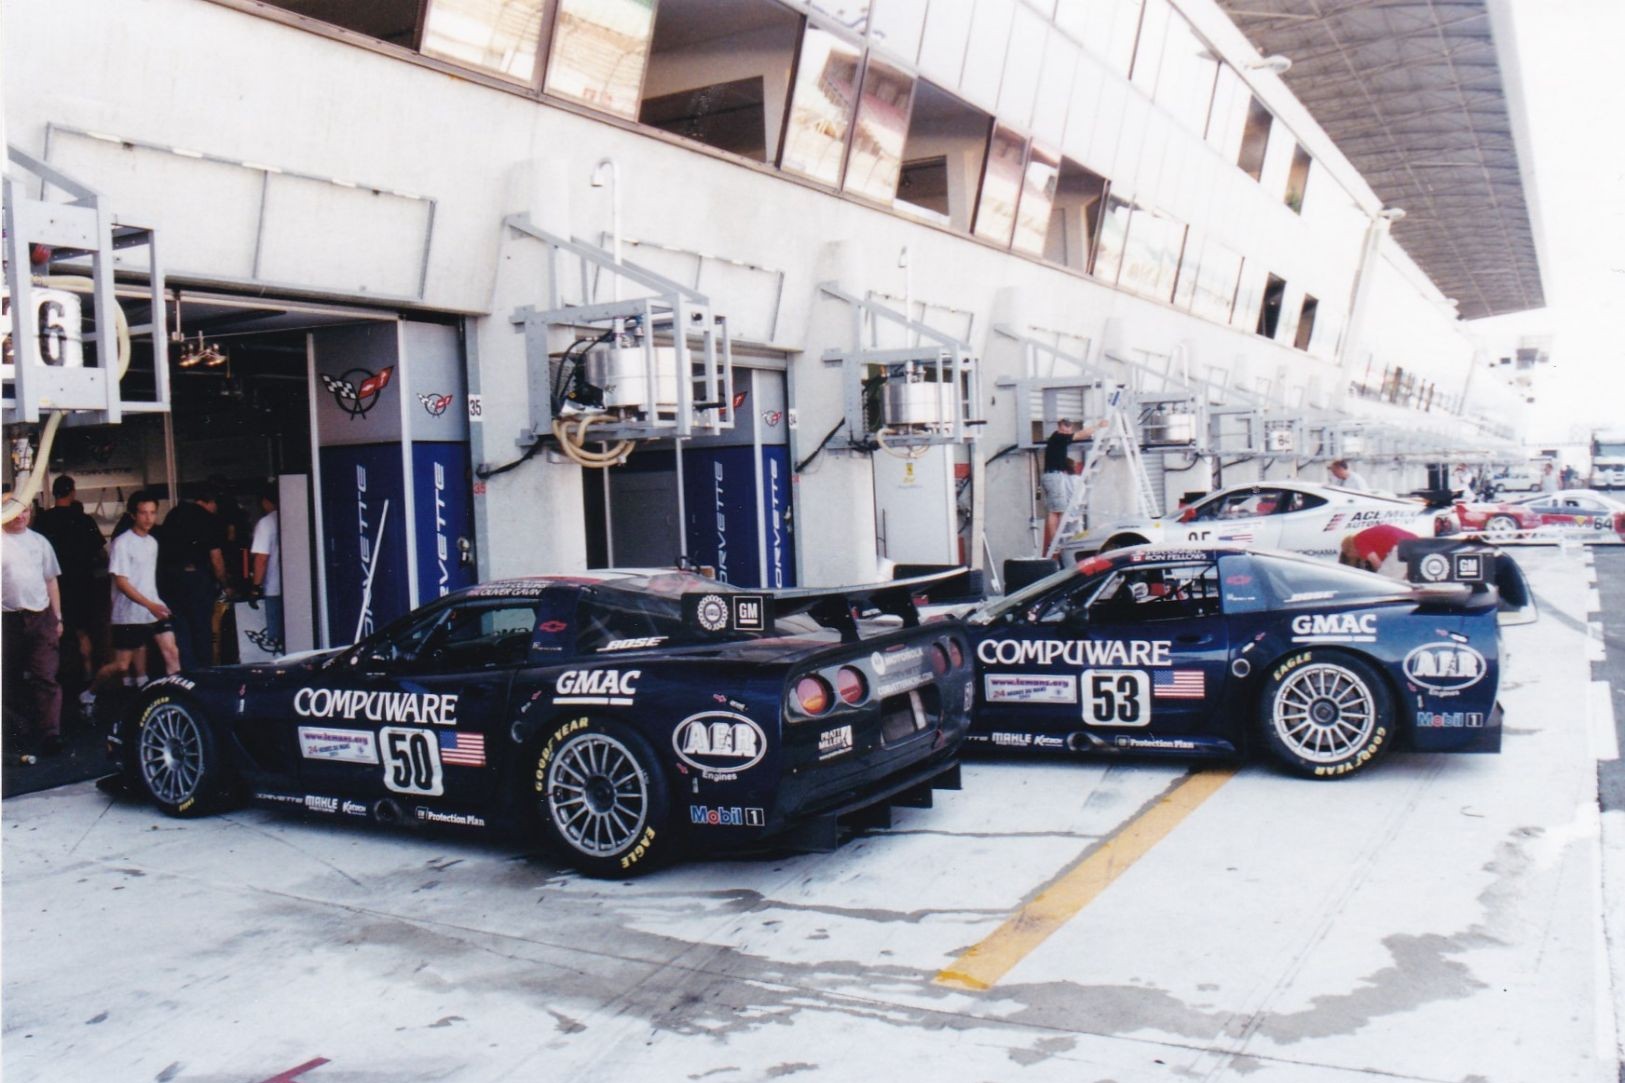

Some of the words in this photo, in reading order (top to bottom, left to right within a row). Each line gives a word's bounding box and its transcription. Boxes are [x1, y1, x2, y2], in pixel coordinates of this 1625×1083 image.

[469, 399, 482, 416] 35
[714, 460, 728, 584] ORVETTE
[769, 457, 782, 589] ORVETTE
[1594, 517, 1613, 530] 64
[1167, 553, 1207, 561] FELLOWS
[739, 602, 758, 619] GM
[1291, 614, 1377, 635] GMAC
[603, 636, 664, 652] BOSE
[976, 638, 1173, 667] COMPUWARE
[1273, 651, 1312, 681] EAGLE
[555, 669, 642, 695] GMAC
[990, 678, 1069, 689] www.lemans.org
[293, 686, 459, 726] COMPUWARE
[1091, 675, 1140, 722] 53
[1416, 711, 1464, 728] Mobil
[682, 720, 757, 757] AER
[991, 731, 1032, 744] MAHLE
[387, 732, 434, 790] 50
[701, 769, 738, 783] Engines
[304, 794, 339, 810] MAHLE
[427, 810, 466, 825] Protection
[466, 815, 486, 827] Plan
[690, 804, 743, 826] Mobil
[620, 826, 656, 869] EAGLE
